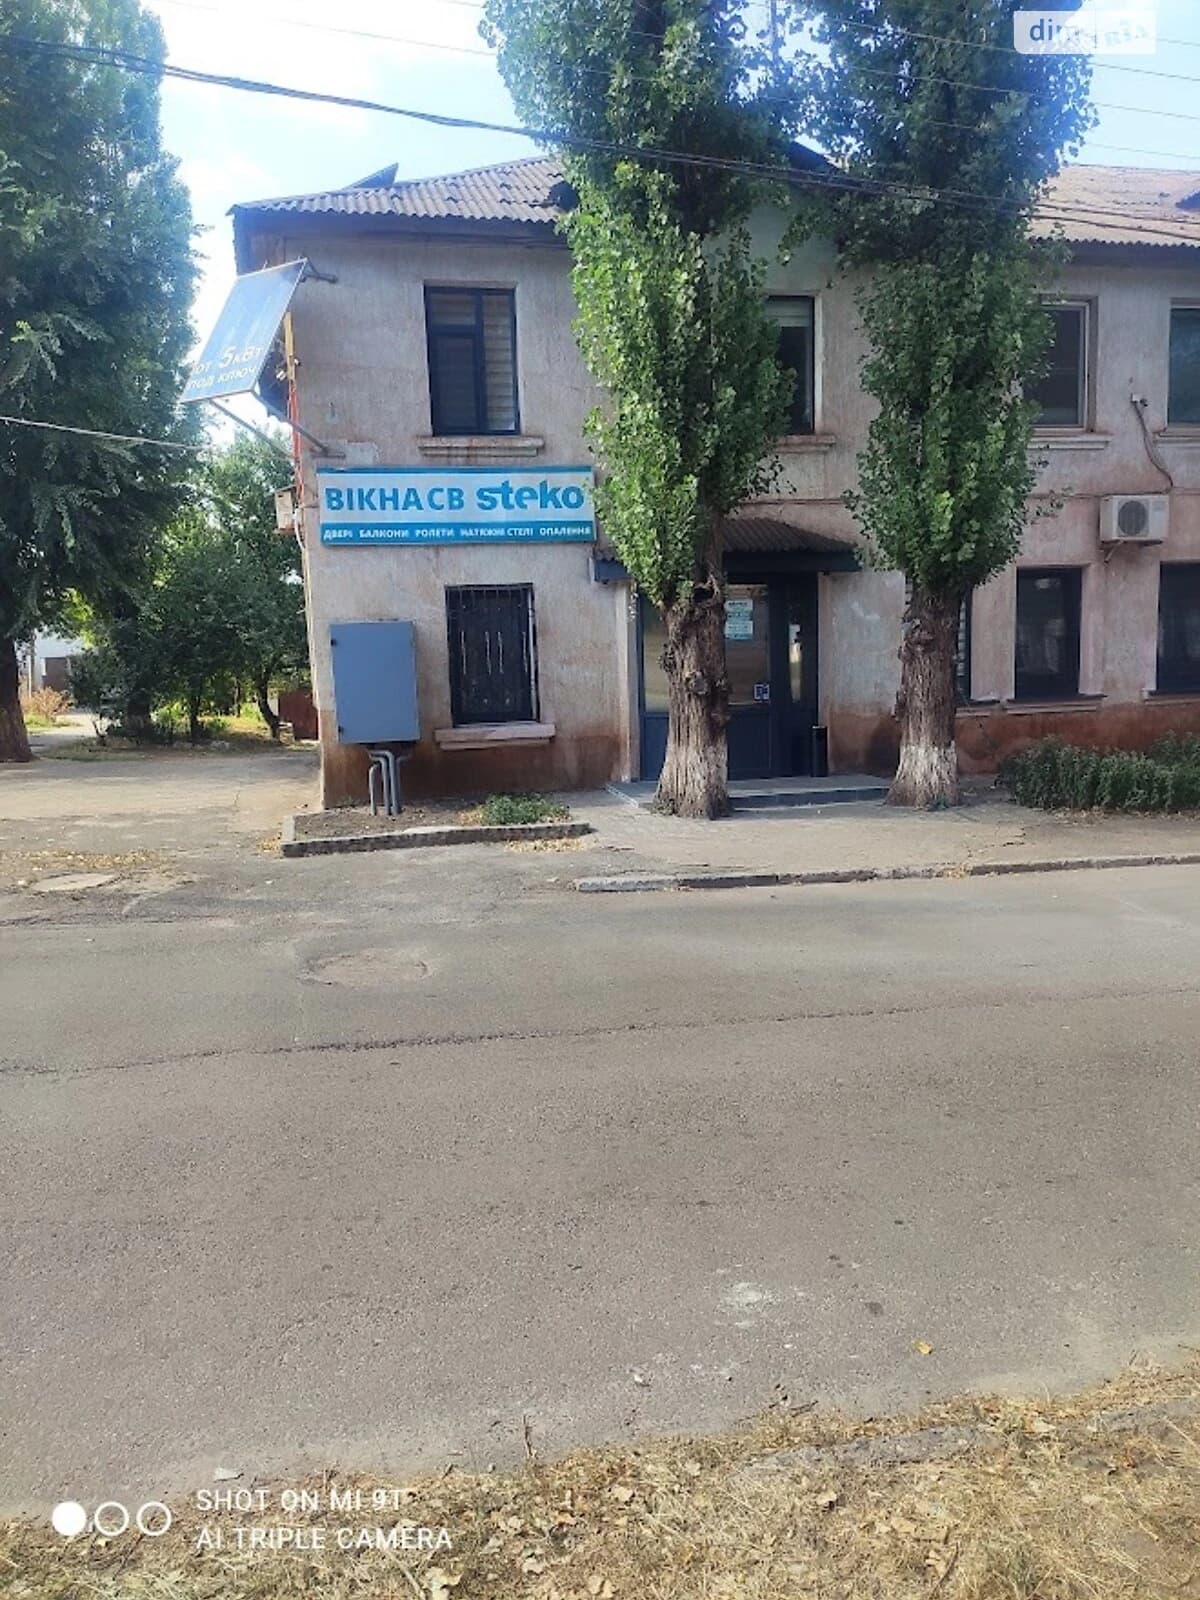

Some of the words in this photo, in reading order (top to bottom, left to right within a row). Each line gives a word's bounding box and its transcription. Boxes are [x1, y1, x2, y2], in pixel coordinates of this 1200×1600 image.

[476, 480, 584, 510] steko
[359, 529, 409, 538] БАЛКОНИ
[415, 528, 454, 538] РОЛЕТИ
[507, 527, 533, 537] СТЕЛІ
[539, 526, 591, 537] ОПАЛЕННЯ
